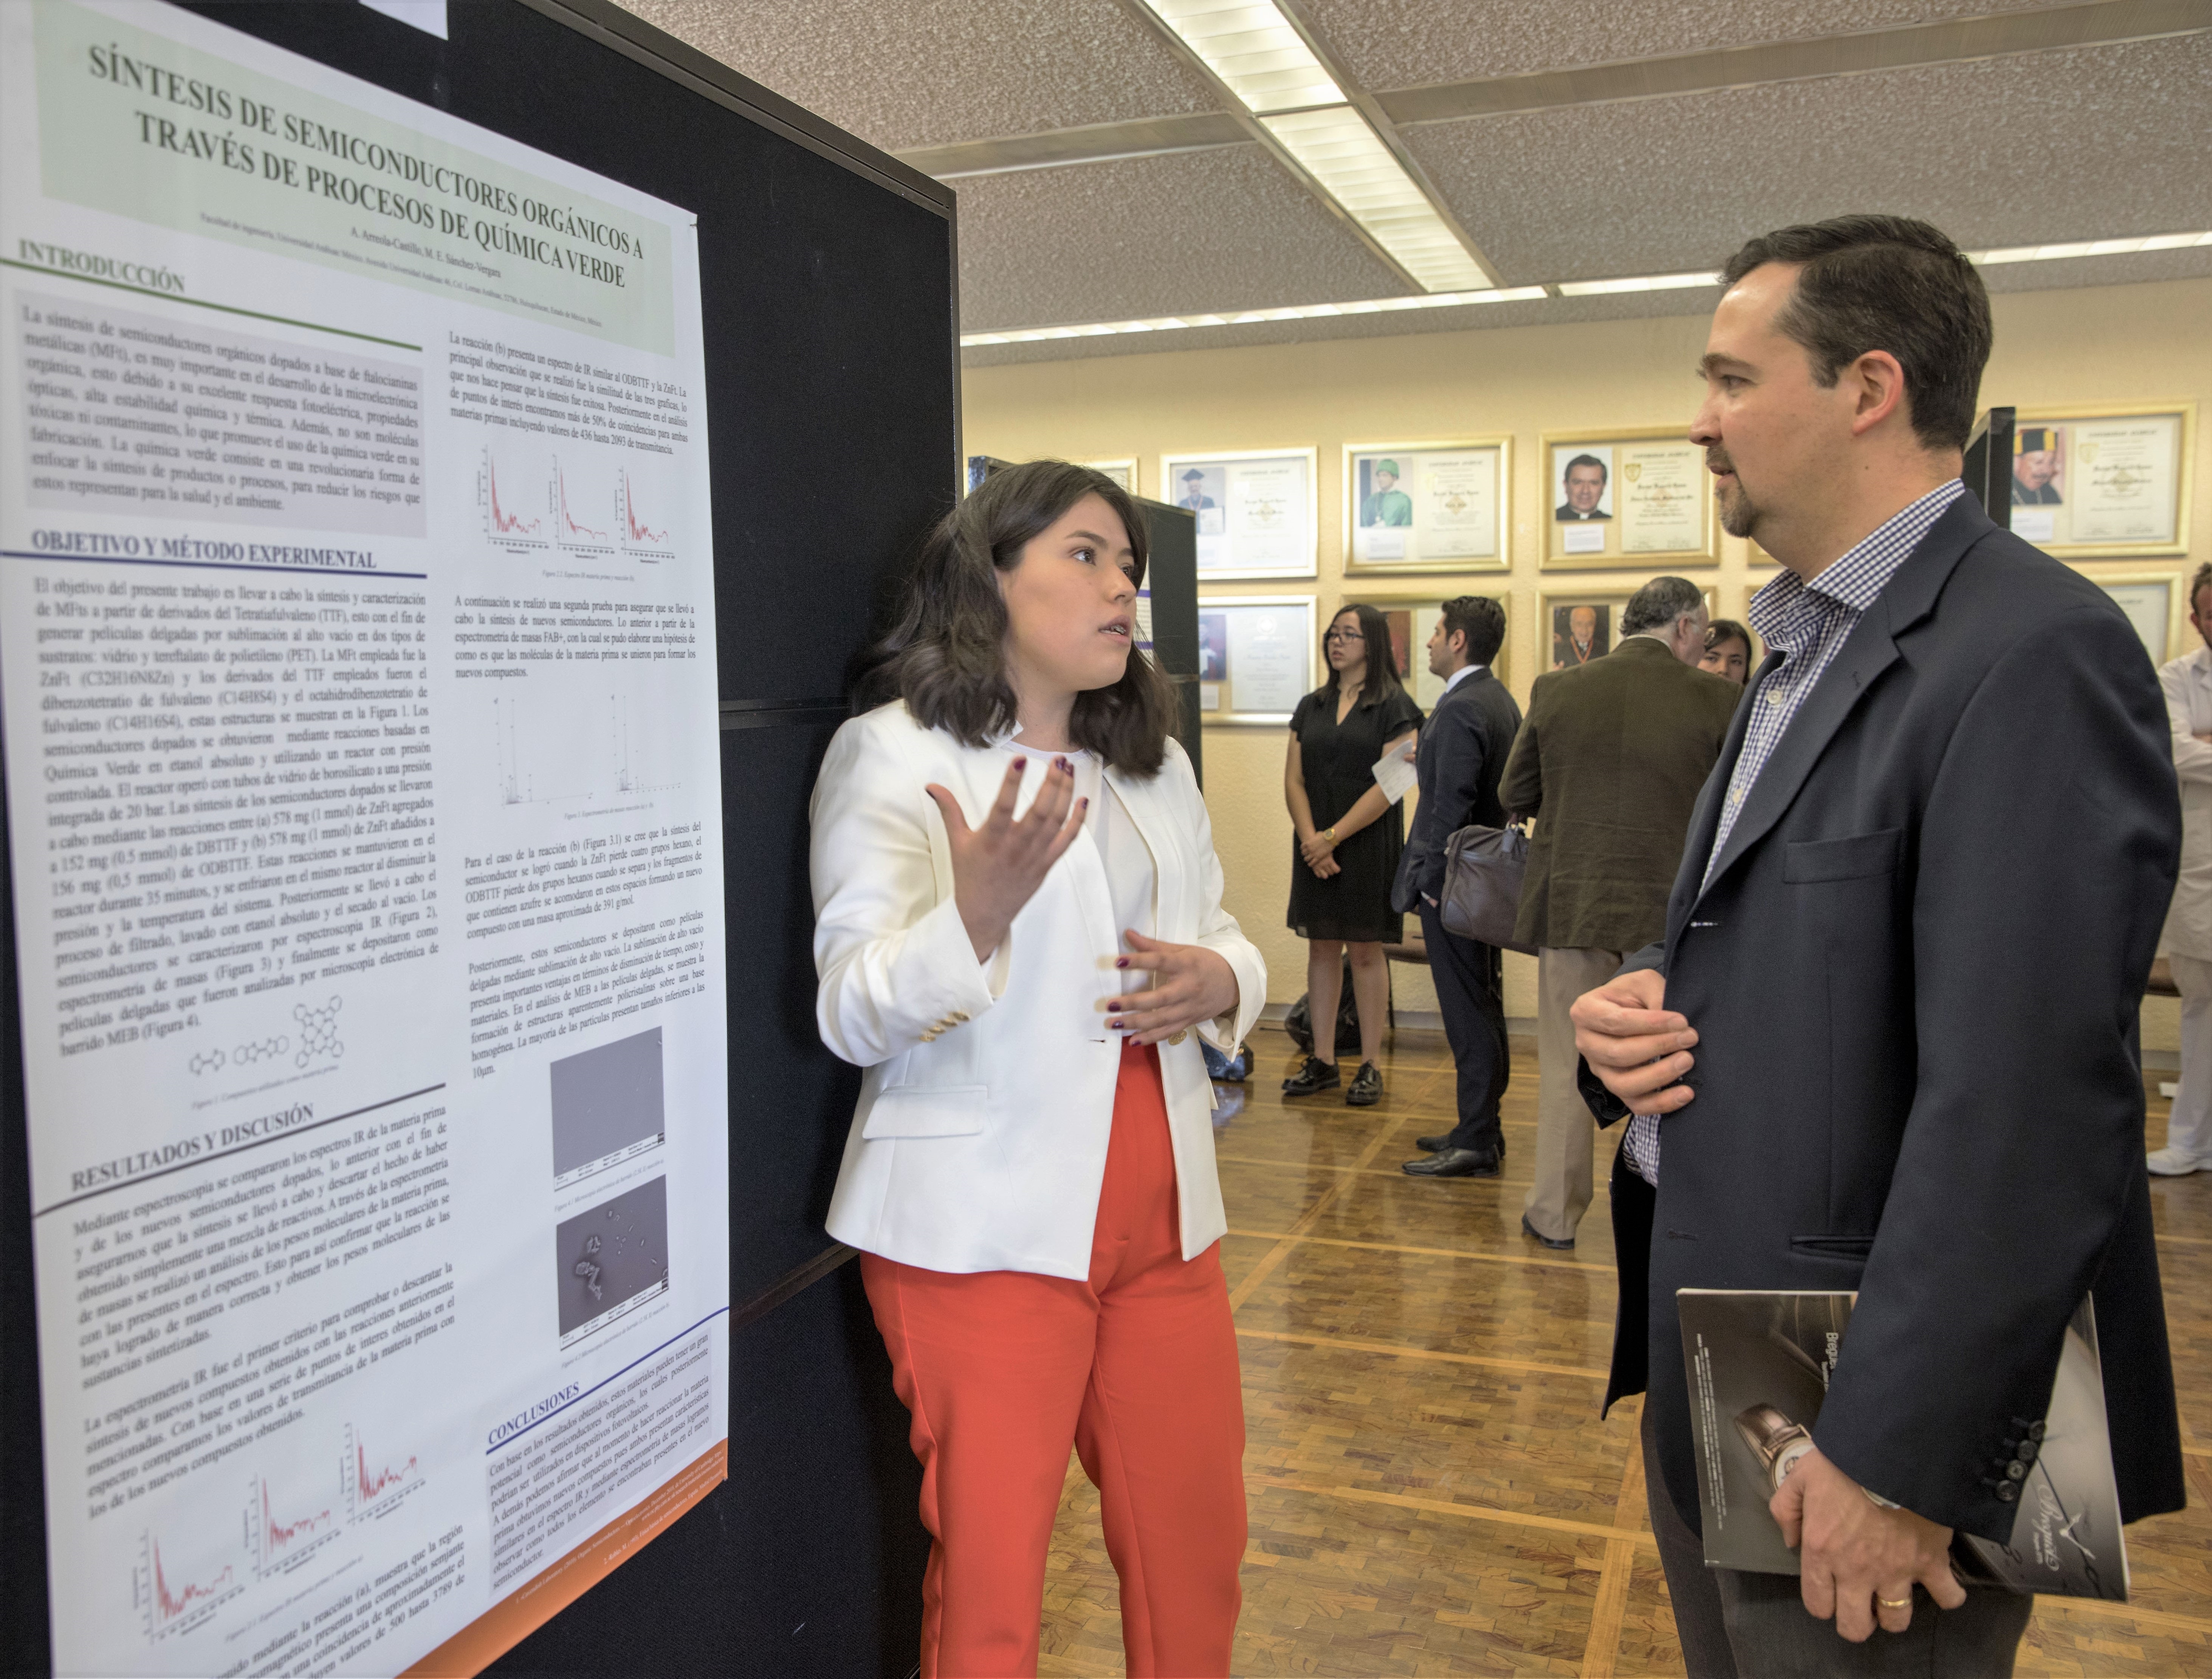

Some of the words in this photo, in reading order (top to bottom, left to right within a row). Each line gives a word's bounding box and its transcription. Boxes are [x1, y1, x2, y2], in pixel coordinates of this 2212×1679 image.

[88, 42, 233, 120] SÍNTESIS
[240, 96, 277, 136] DE
[283, 113, 518, 217] SEMICONDUCTORES
[522, 198, 630, 255] ORGÁNICOS
[632, 238, 644, 260] A
[134, 110, 255, 174] TRAVÉS
[262, 150, 299, 189] DE
[306, 165, 435, 229] PROCESOS
[440, 208, 469, 241] DE
[474, 220, 564, 270] QUÍMICA
[565, 248, 626, 289] VERDE
[18, 237, 185, 293] INTRODUCCIÓN
[449, 330, 460, 345] La
[462, 337, 493, 352] reacción
[495, 342, 506, 356] (b)
[507, 348, 536, 362] presenta
[537, 355, 545, 365] un
[547, 357, 573, 371] espectro
[574, 362, 582, 374] de
[584, 364, 591, 376] IR
[593, 369, 613, 381] similar
[615, 372, 621, 382] al
[622, 373, 649, 389] ODBTTF
[651, 382, 655, 393] y
[657, 381, 662, 392] la
[679, 386, 687, 398] La
[450, 407, 483, 421] materias
[484, 413, 508, 426] primas
[509, 417, 545, 433] incluyendo
[547, 424, 570, 437] valores
[571, 427, 579, 439] de
[580, 429, 592, 441] 436
[593, 431, 610, 444] hasta
[611, 434, 626, 447] 2093
[627, 437, 634, 448] de
[635, 440, 674, 455] transmitancia.
[30, 529, 141, 556] OBJETIVO
[143, 535, 158, 557] Y
[161, 534, 245, 562] MÉTODO
[248, 543, 377, 569] EXPERIMENTAL
[455, 595, 462, 607] A
[464, 597, 510, 608] continuación
[513, 600, 520, 608] se
[523, 597, 547, 609] realizó
[549, 601, 561, 610] una
[564, 599, 590, 613] segunda
[592, 600, 613, 613] prueba
[615, 604, 628, 614] para
[630, 604, 654, 615] asegurar
[655, 605, 666, 615] que
[675, 603, 689, 614] llevó
[455, 669, 483, 678] nuevos
[484, 667, 528, 680] compuestos.
[464, 857, 482, 869] Para
[485, 854, 493, 866] el
[496, 854, 513, 864] caso
[516, 849, 524, 861] de
[528, 848, 535, 859] la
[538, 843, 567, 857] reacción
[570, 840, 580, 853] (b)
[583, 838, 606, 851] (Figura
[624, 835, 631, 843] se
[634, 833, 646, 842] cree
[649, 830, 659, 841] que
[662, 826, 668, 837] la
[692, 821, 701, 832] del
[467, 923, 507, 939] compuesto
[508, 920, 520, 931] con
[522, 917, 535, 928] una
[536, 913, 555, 924] masa
[555, 903, 593, 923] aproximada
[594, 901, 602, 912] de
[603, 898, 614, 910] 391
[469, 954, 525, 975] Posteriormente,
[531, 948, 548, 960] estos
[553, 935, 607, 955] semiconductores
[612, 932, 618, 940] se
[623, 922, 655, 938] depositaron
[660, 918, 675, 928] como
[680, 910, 703, 926] películas
[71, 1138, 201, 1193] RESULTADOS
[204, 1132, 217, 1152] Y
[220, 1102, 314, 1148] DISCUSIÓN
[488, 1382, 579, 1445] CONCLUSIONES
[489, 1462, 505, 1477] Con
[506, 1452, 522, 1467] base
[524, 1445, 532, 1456] en
[534, 1438, 544, 1450] los
[545, 1418, 577, 1443] resultados
[578, 1399, 609, 1422] obtenidos,
[610, 1388, 626, 1402] estos
[627, 1369, 655, 1392] materiales
[656, 1356, 674, 1376] pueden
[675, 1346, 689, 1360] tener
[689, 1342, 696, 1352] un
[697, 1334, 708, 1349] gran
[519, 1478, 530, 1492] ser
[533, 1456, 564, 1483] utilizados
[565, 1451, 573, 1461] en
[574, 1427, 611, 1456] dispositivos
[612, 1402, 649, 1431] fotovoltaicos.
